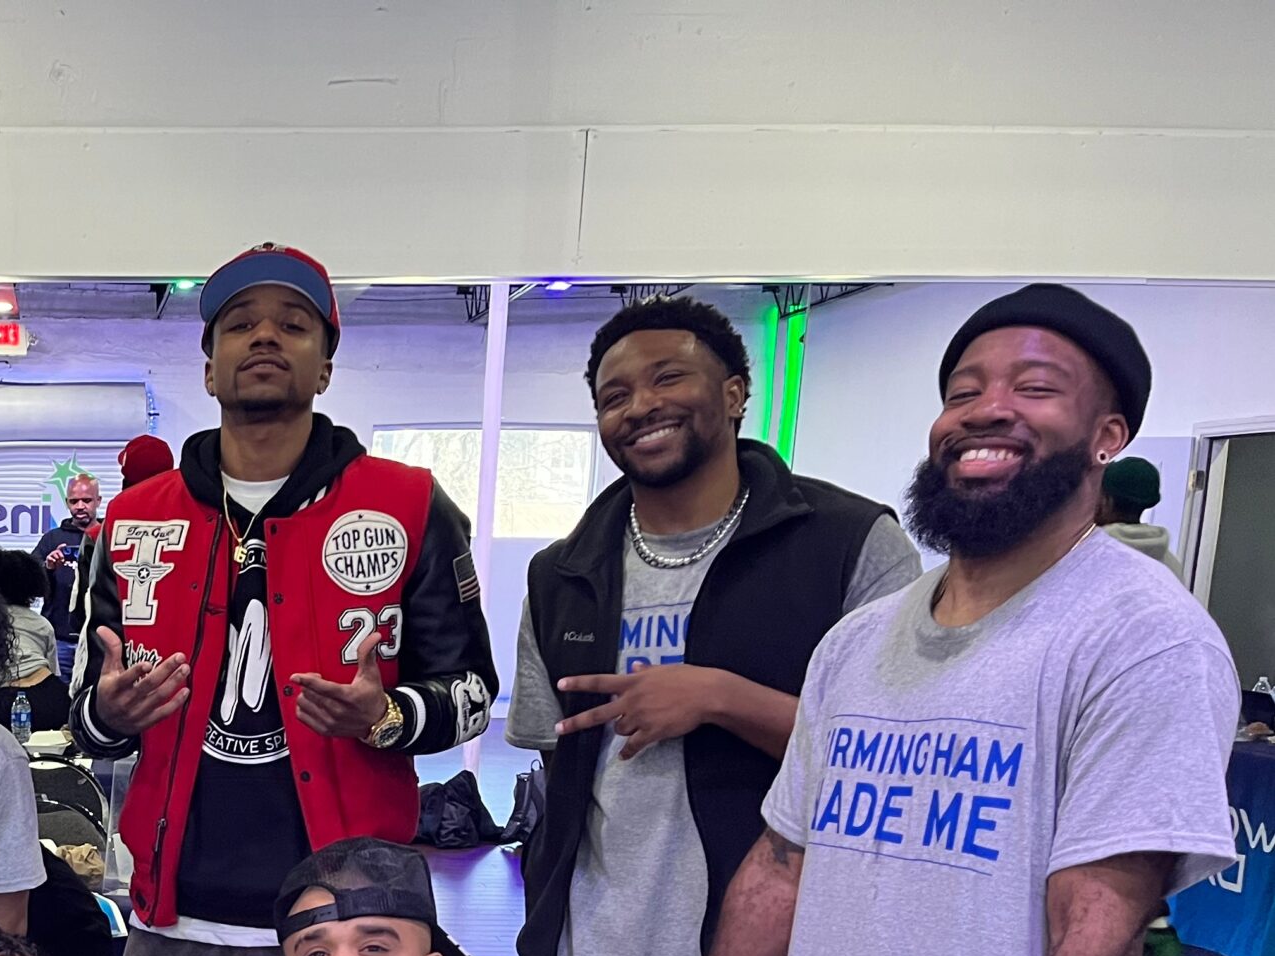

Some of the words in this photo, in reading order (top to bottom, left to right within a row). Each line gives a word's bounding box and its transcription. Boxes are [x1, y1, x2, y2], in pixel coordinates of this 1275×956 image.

[333, 529, 360, 550] TOP
[364, 528, 396, 547] GUN
[335, 551, 398, 578] CHAMPS
[339, 604, 403, 664] 23
[265, 731, 287, 751] SP
[825, 727, 1023, 787] IRMINGHAM
[811, 778, 914, 844] ADE
[923, 789, 1012, 861] ME
